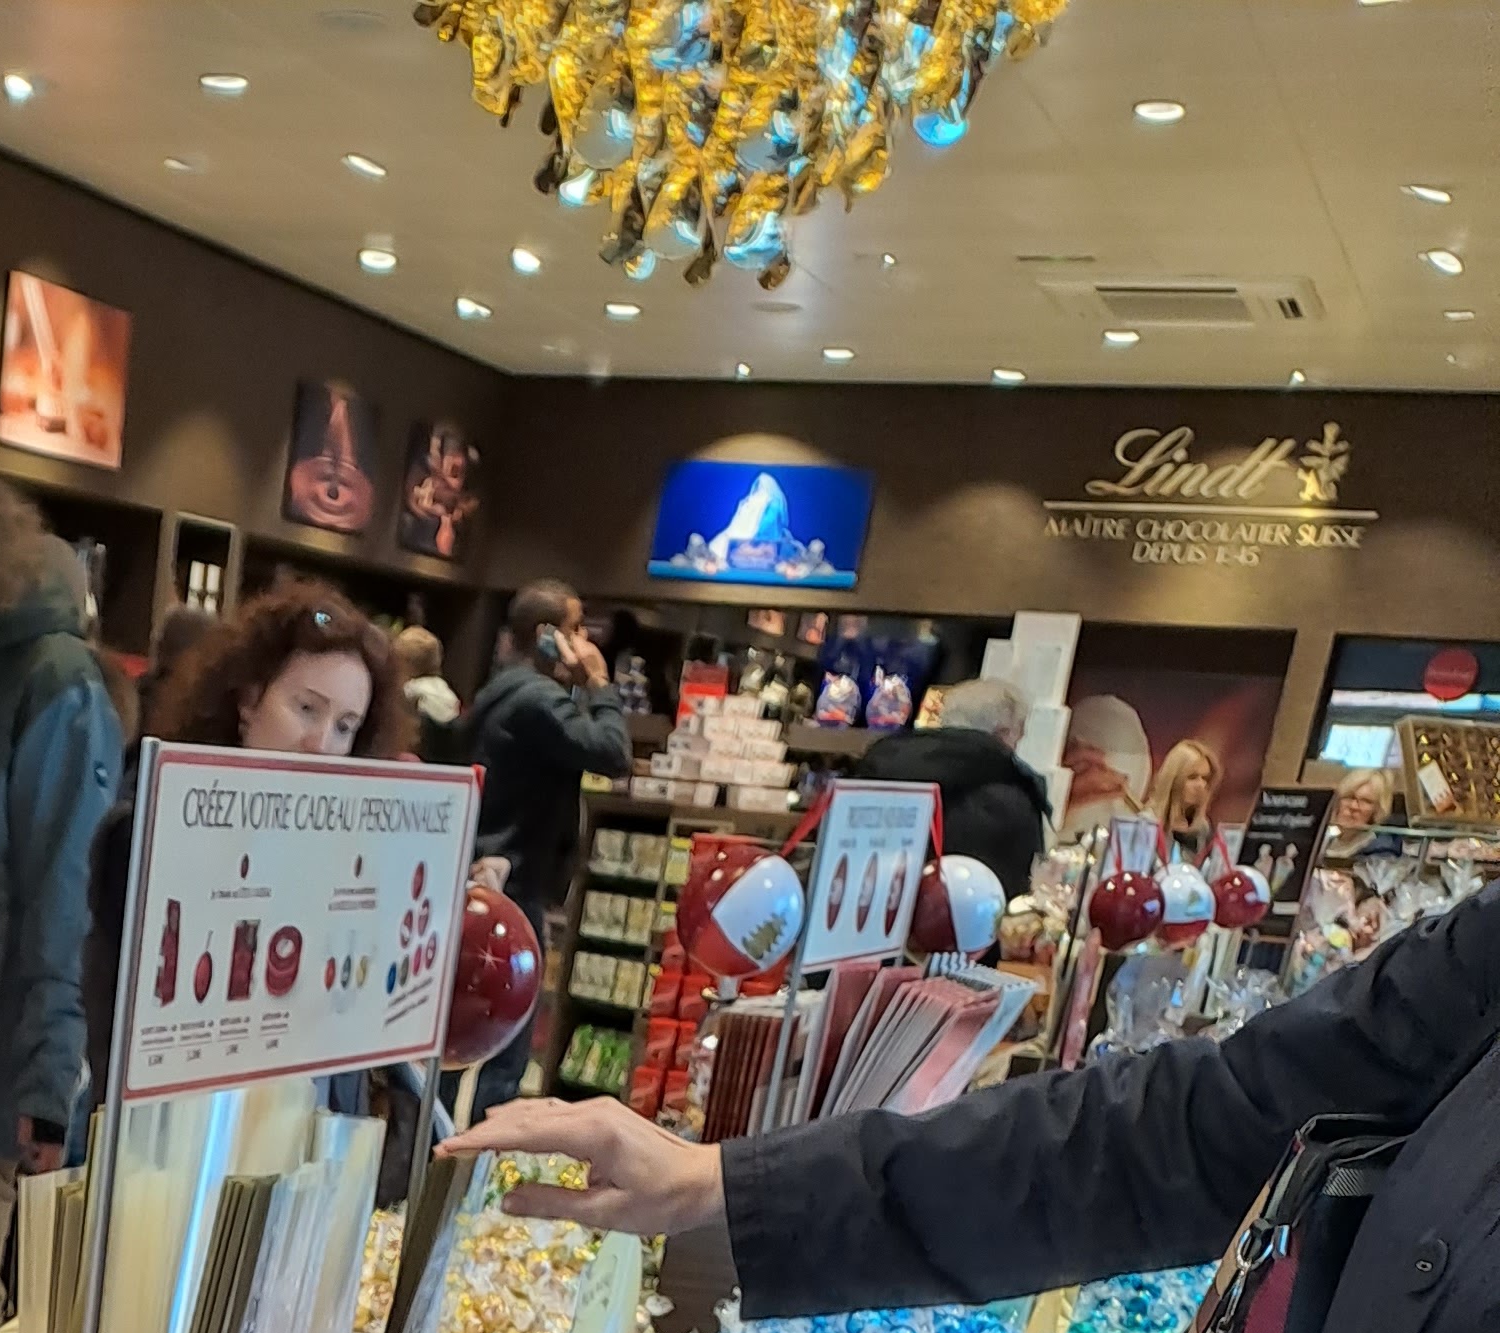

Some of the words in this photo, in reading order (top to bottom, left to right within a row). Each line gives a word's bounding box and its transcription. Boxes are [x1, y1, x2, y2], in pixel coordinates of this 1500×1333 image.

[1084, 426, 1296, 499] Lindt
[1131, 541, 1208, 565] DEPUIS
[1135, 517, 1291, 547] CHOCOLATIER
[1295, 522, 1366, 550] SUISSE
[183, 779, 238, 828] CRÉEZ
[241, 790, 293, 830] VOTRE
[294, 792, 354, 832] CADEAU
